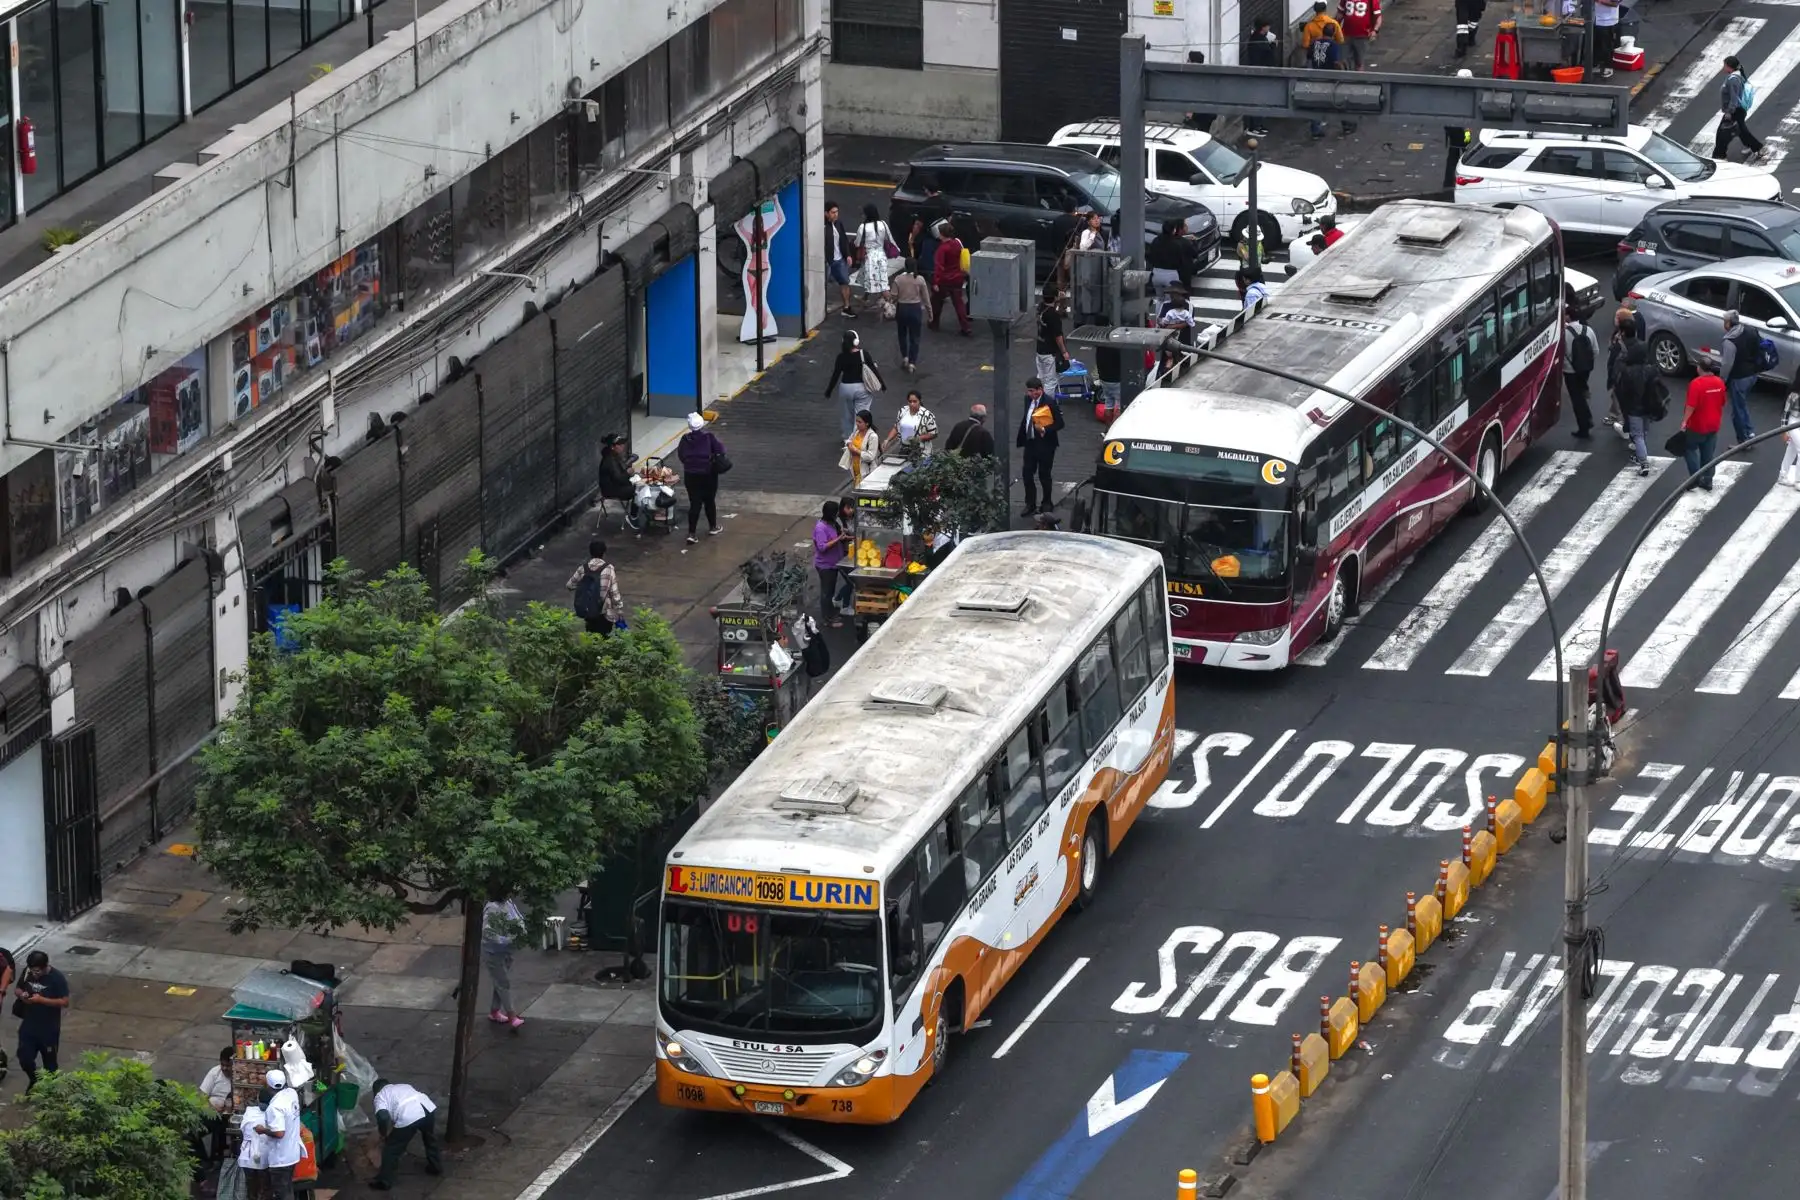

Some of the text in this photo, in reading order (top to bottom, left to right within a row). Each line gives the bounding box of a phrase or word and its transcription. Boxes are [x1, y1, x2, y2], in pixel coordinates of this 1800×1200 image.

[1217, 450, 1260, 464] MAGDALENA
[1167, 581, 1204, 596] TUSA
[1060, 775, 1081, 812] ABANCAY
[1252, 739, 1527, 832] SOLO
[1038, 811, 1051, 839] ACHO
[1015, 832, 1033, 865] FLORES
[668, 866, 689, 893] L
[699, 872, 754, 898] LURIGANCHO
[757, 880, 784, 901] 1098
[790, 879, 873, 906] LURIN
[1110, 925, 1343, 1026] BUS
[732, 1039, 804, 1053] ETUL 4 SA
[831, 1100, 853, 1112] 738
